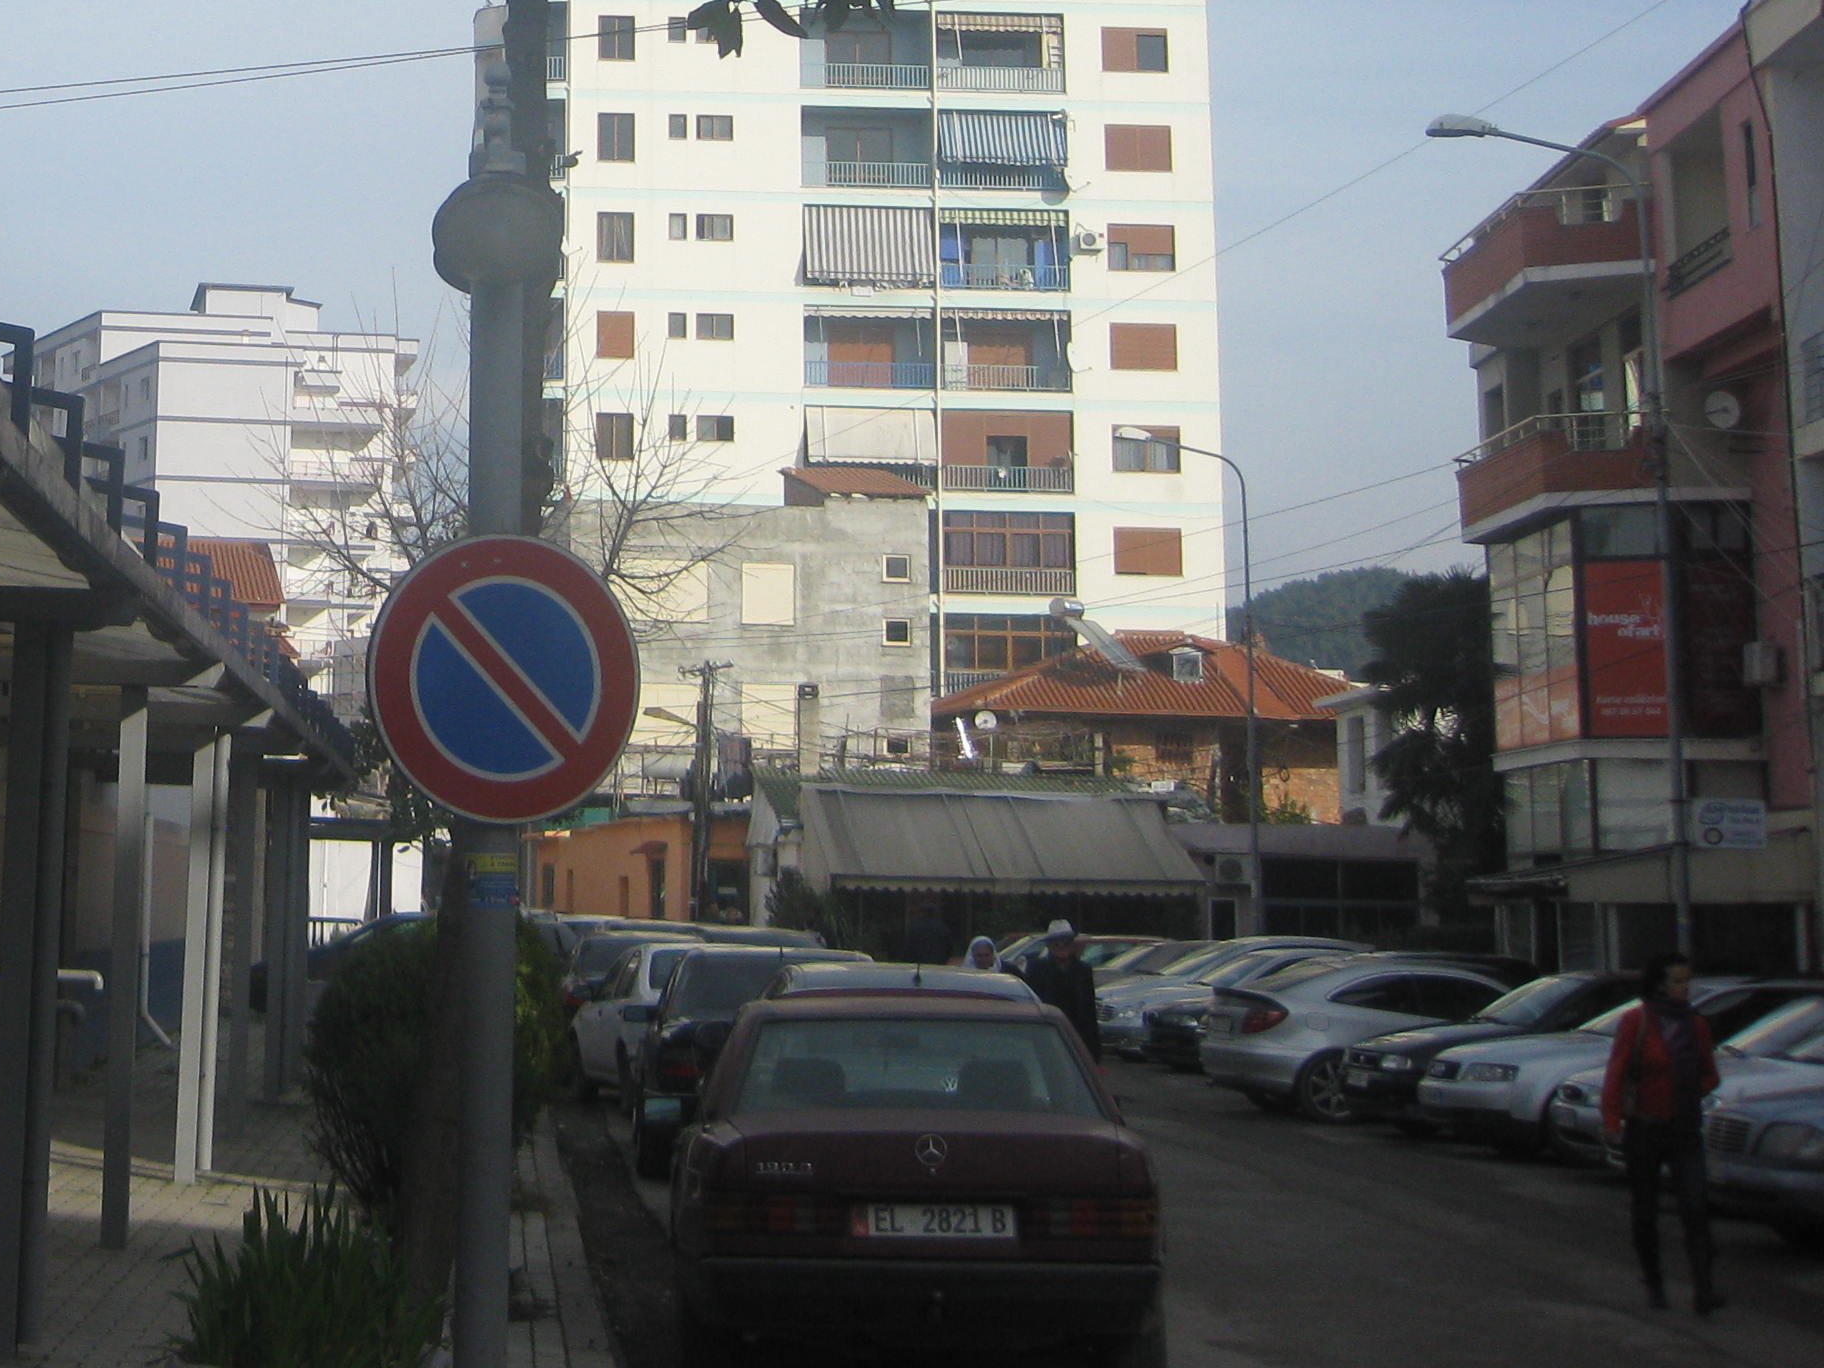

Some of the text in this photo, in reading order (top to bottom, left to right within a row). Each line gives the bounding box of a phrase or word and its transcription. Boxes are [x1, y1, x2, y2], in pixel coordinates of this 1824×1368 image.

[874, 1207, 1006, 1234] EL 2821 B
